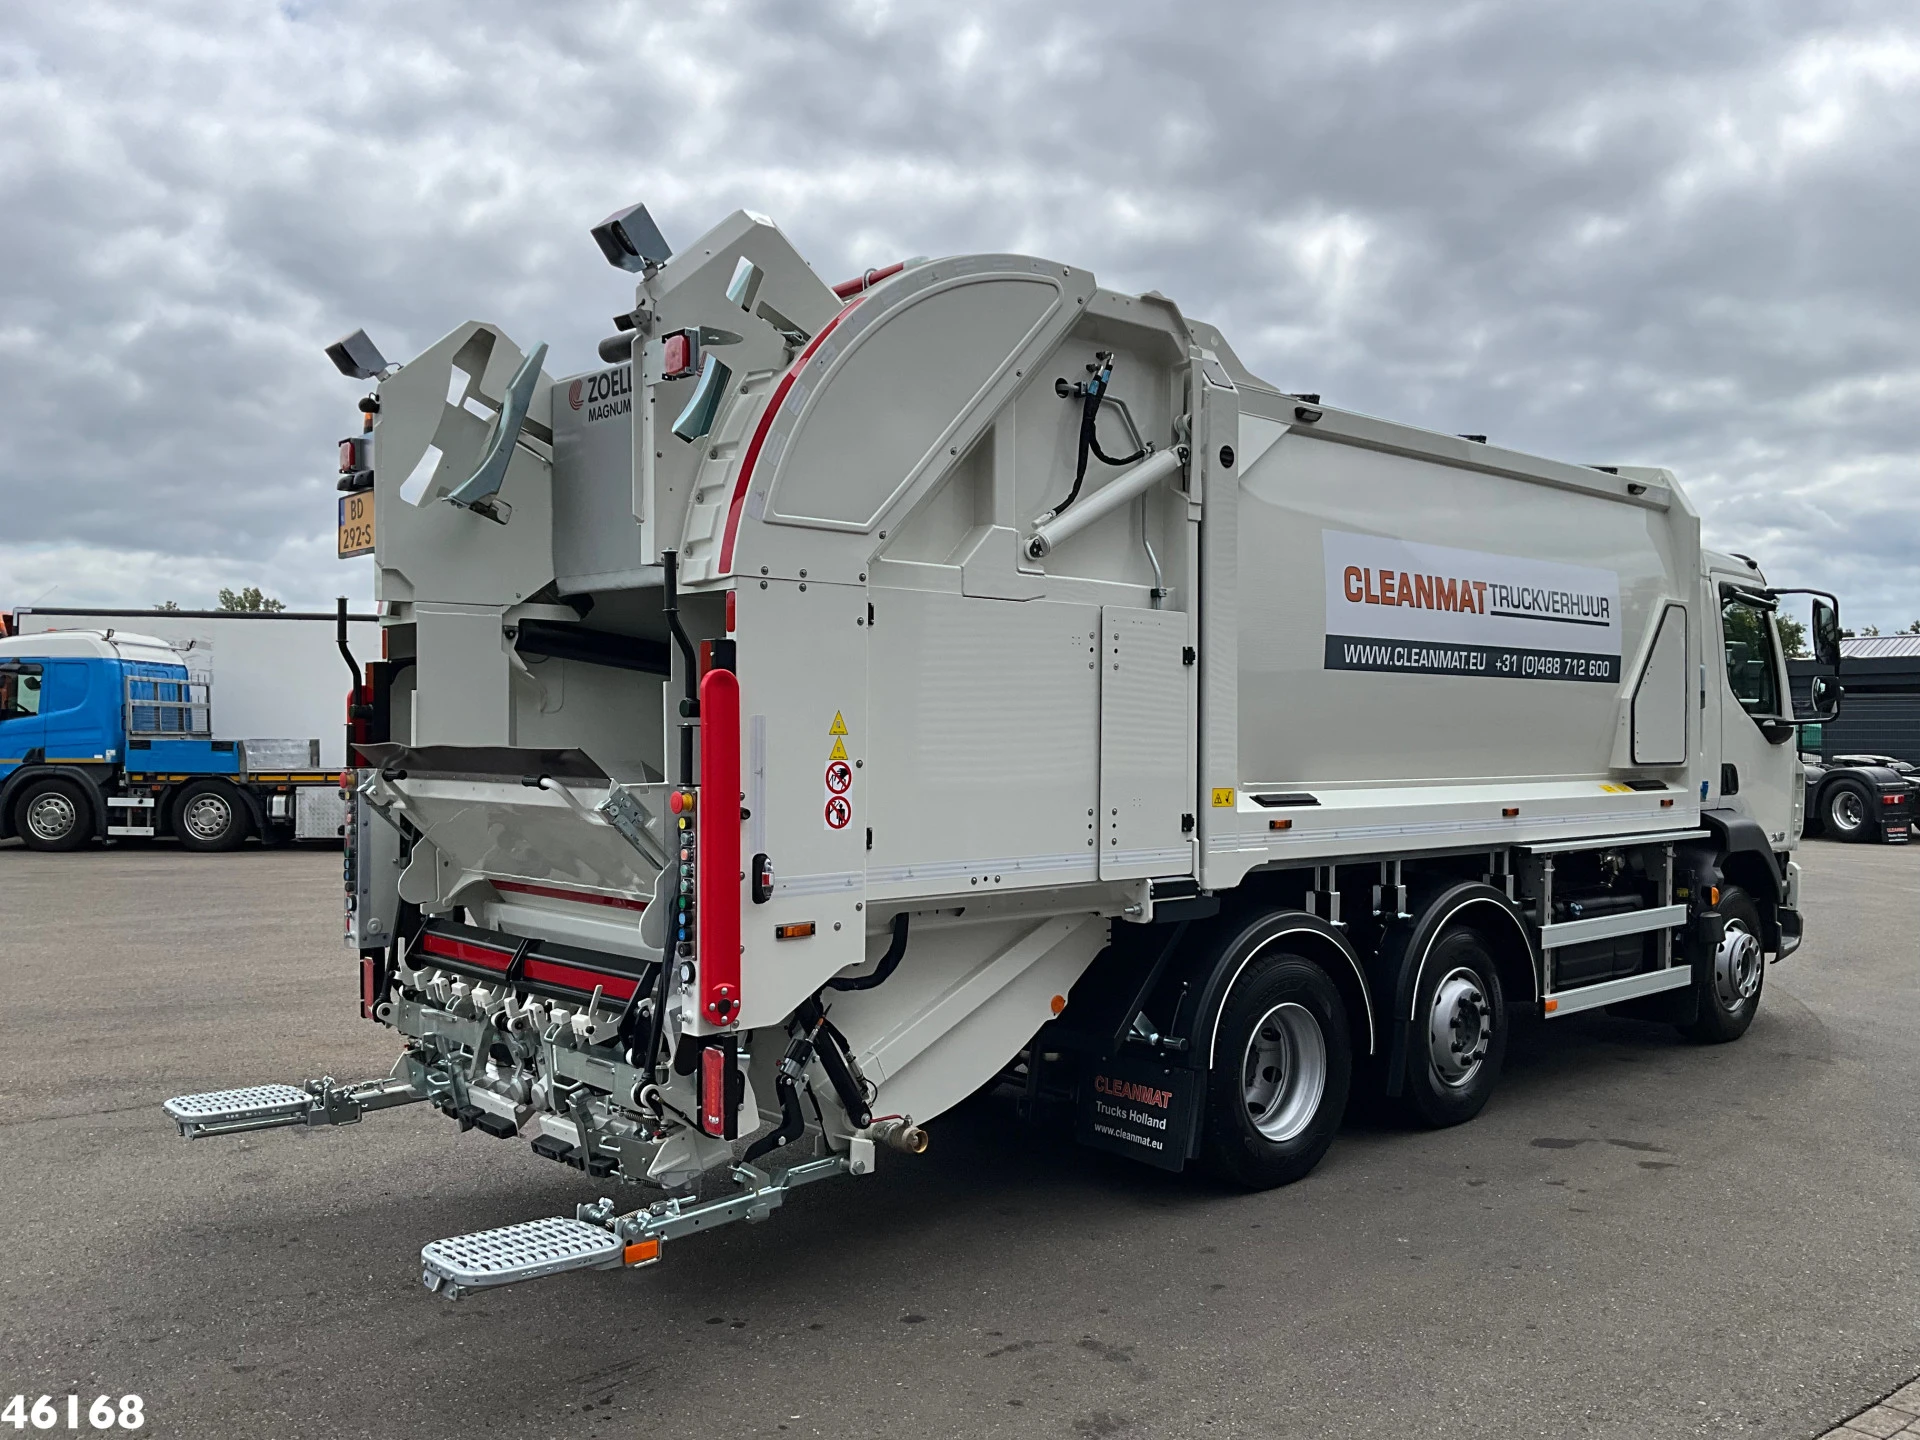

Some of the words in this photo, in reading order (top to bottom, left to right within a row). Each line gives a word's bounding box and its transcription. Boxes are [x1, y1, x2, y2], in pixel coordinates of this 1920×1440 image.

[588, 398, 632, 422] MAGNUM
[350, 498, 364, 520] BD
[343, 523, 372, 549] 292-S
[1344, 565, 1487, 614] CLEANMAT
[1488, 583, 1610, 619] TRUCKVERHUUR
[1344, 643, 1487, 670] WWW.CLEANMAT.EU
[1495, 655, 1517, 673] +31
[1522, 655, 1560, 677] (0)488
[1564, 658, 1585, 676] 712
[1588, 660, 1610, 677] 600
[1094, 1075, 1172, 1109] CLEANMAT
[1096, 1100, 1127, 1119] Trucks
[1129, 1109, 1167, 1130] Holland
[1094, 1123, 1163, 1150] www.cleanmat.eu
